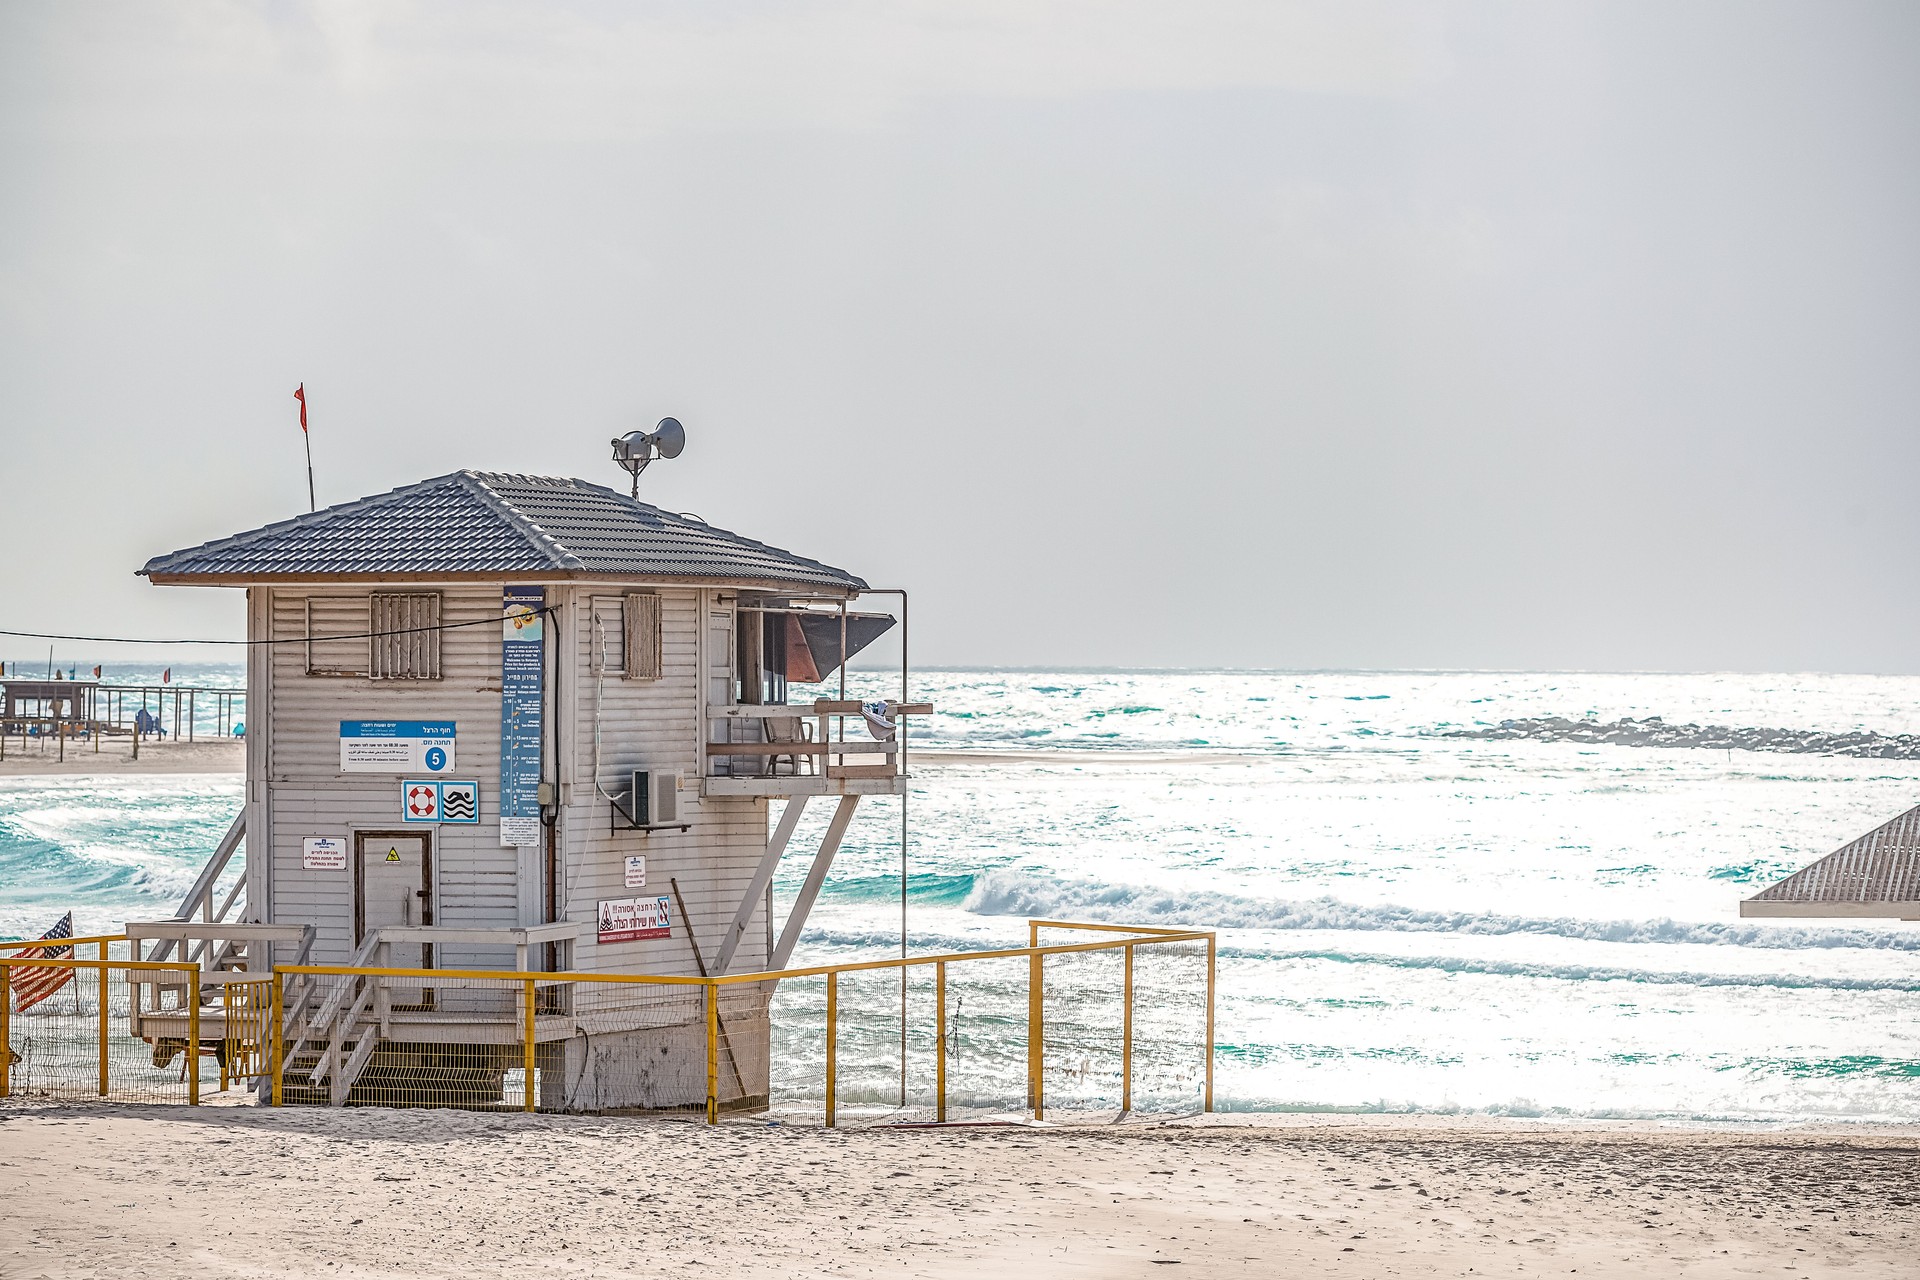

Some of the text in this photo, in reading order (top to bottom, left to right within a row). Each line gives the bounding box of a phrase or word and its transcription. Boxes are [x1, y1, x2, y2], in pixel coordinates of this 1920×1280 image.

[432, 752, 440, 765] 5
[637, 904, 657, 912] הרחצה
[614, 916, 628, 929] הצלה
[630, 916, 647, 928] שירותי
